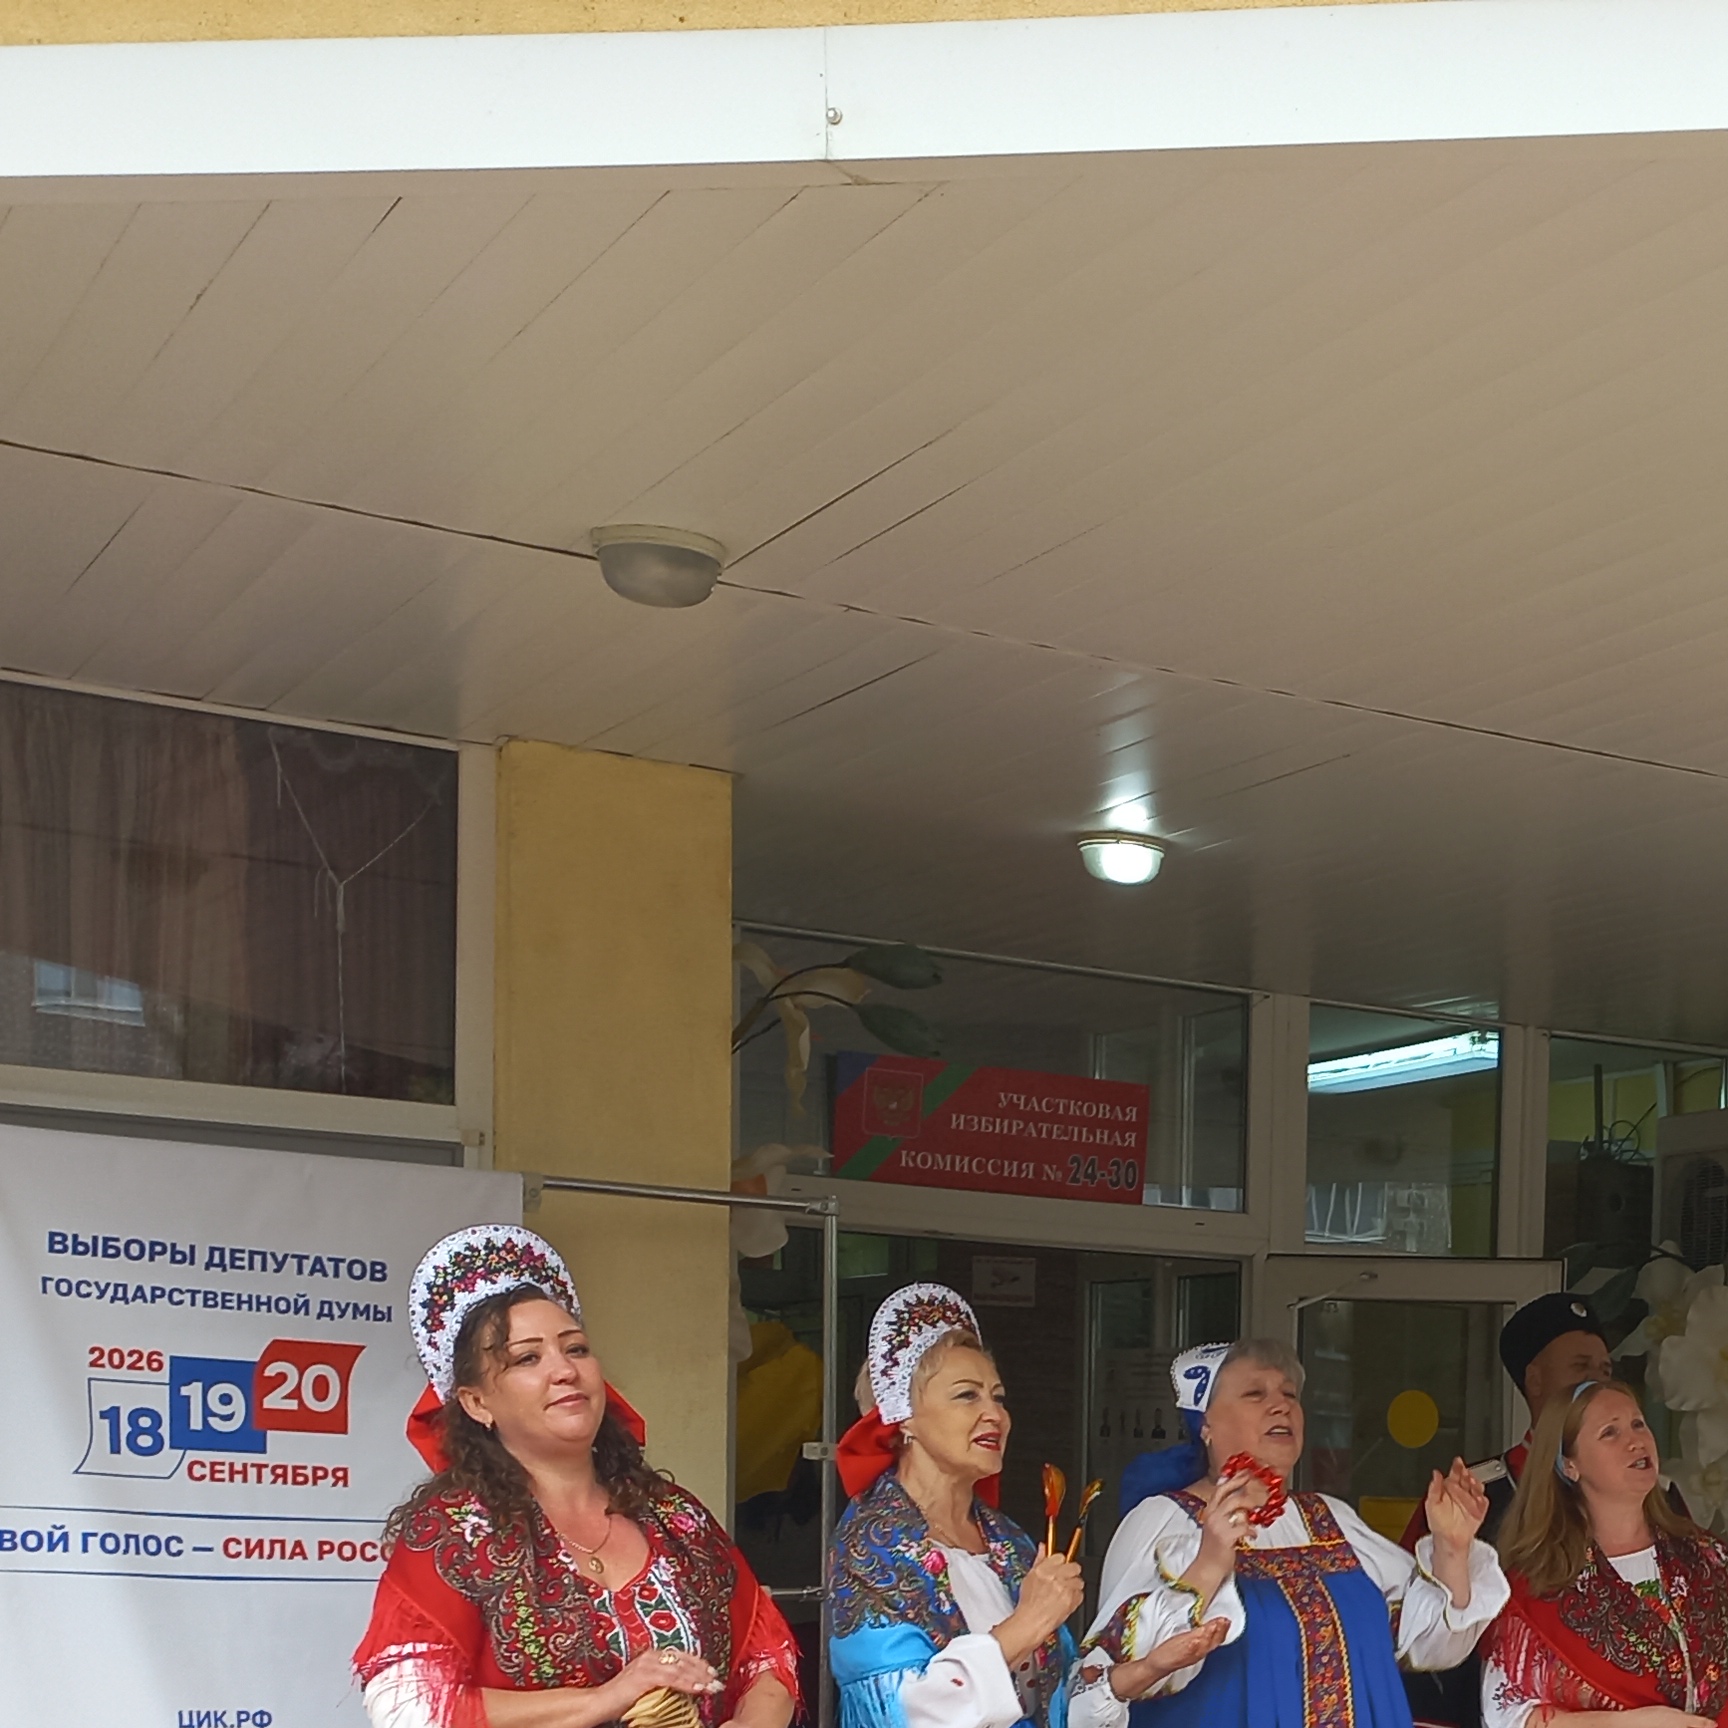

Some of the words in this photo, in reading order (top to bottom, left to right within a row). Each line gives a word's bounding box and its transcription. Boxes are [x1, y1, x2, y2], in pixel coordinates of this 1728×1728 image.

[998, 1092, 1138, 1122] УЧАСТКОВАЯ
[951, 1113, 1137, 1148] ИЗБИРАТЕЛЬНАЯ
[900, 1150, 1035, 1179] КОМИССИЯ
[1067, 1154, 1138, 1190] 24-30
[47, 1231, 196, 1266] ВЫБОРЫ
[204, 1246, 388, 1282] ДЕПУТАТОВ
[41, 1276, 310, 1317] ГОСУДАРСТВЕННОЙ
[316, 1301, 393, 1323] ДУМЫ
[88, 1346, 165, 1372] 2026
[99, 1405, 165, 1457] 18
[179, 1381, 246, 1433] 19
[262, 1361, 341, 1412] 20
[187, 1460, 349, 1488] СЕНТЯБРЯ
[82, 1532, 185, 1558] ГОЛОС
[222, 1537, 309, 1561] СИЛА
